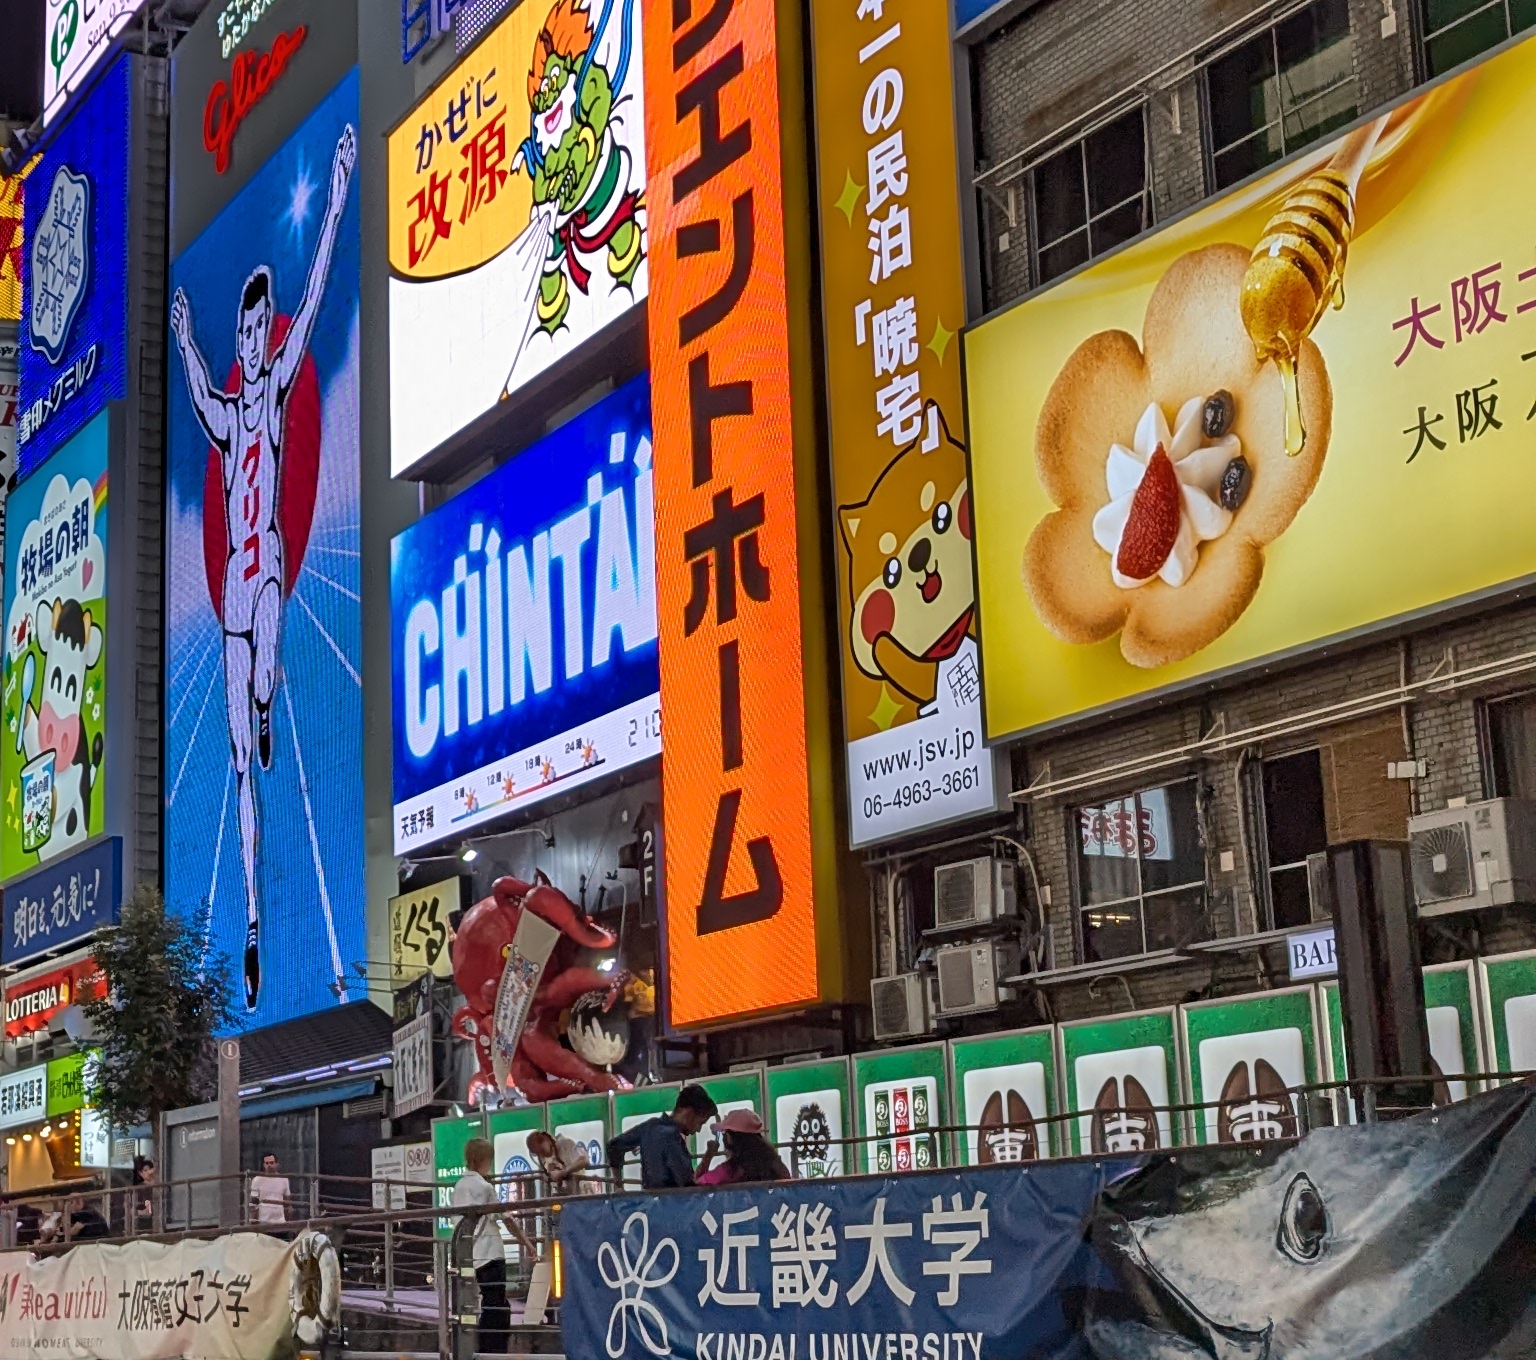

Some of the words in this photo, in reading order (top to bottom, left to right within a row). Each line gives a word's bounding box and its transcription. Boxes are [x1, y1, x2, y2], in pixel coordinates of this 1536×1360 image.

[203, 24, 307, 175] Glico
[414, 65, 498, 174] かぜに
[407, 102, 509, 271] 改源
[18, 343, 97, 446] 雪印メグミルク
[20, 496, 90, 597] 牧場の朝
[240, 431, 264, 584] グリコ
[863, 723, 975, 782] www.jsv.jp
[863, 764, 981, 819] 06-4963-3661
[400, 804, 435, 840] 天気予報
[5, 985, 58, 1023] LOTTERIA
[697, 1188, 993, 1310] 近畿大学
